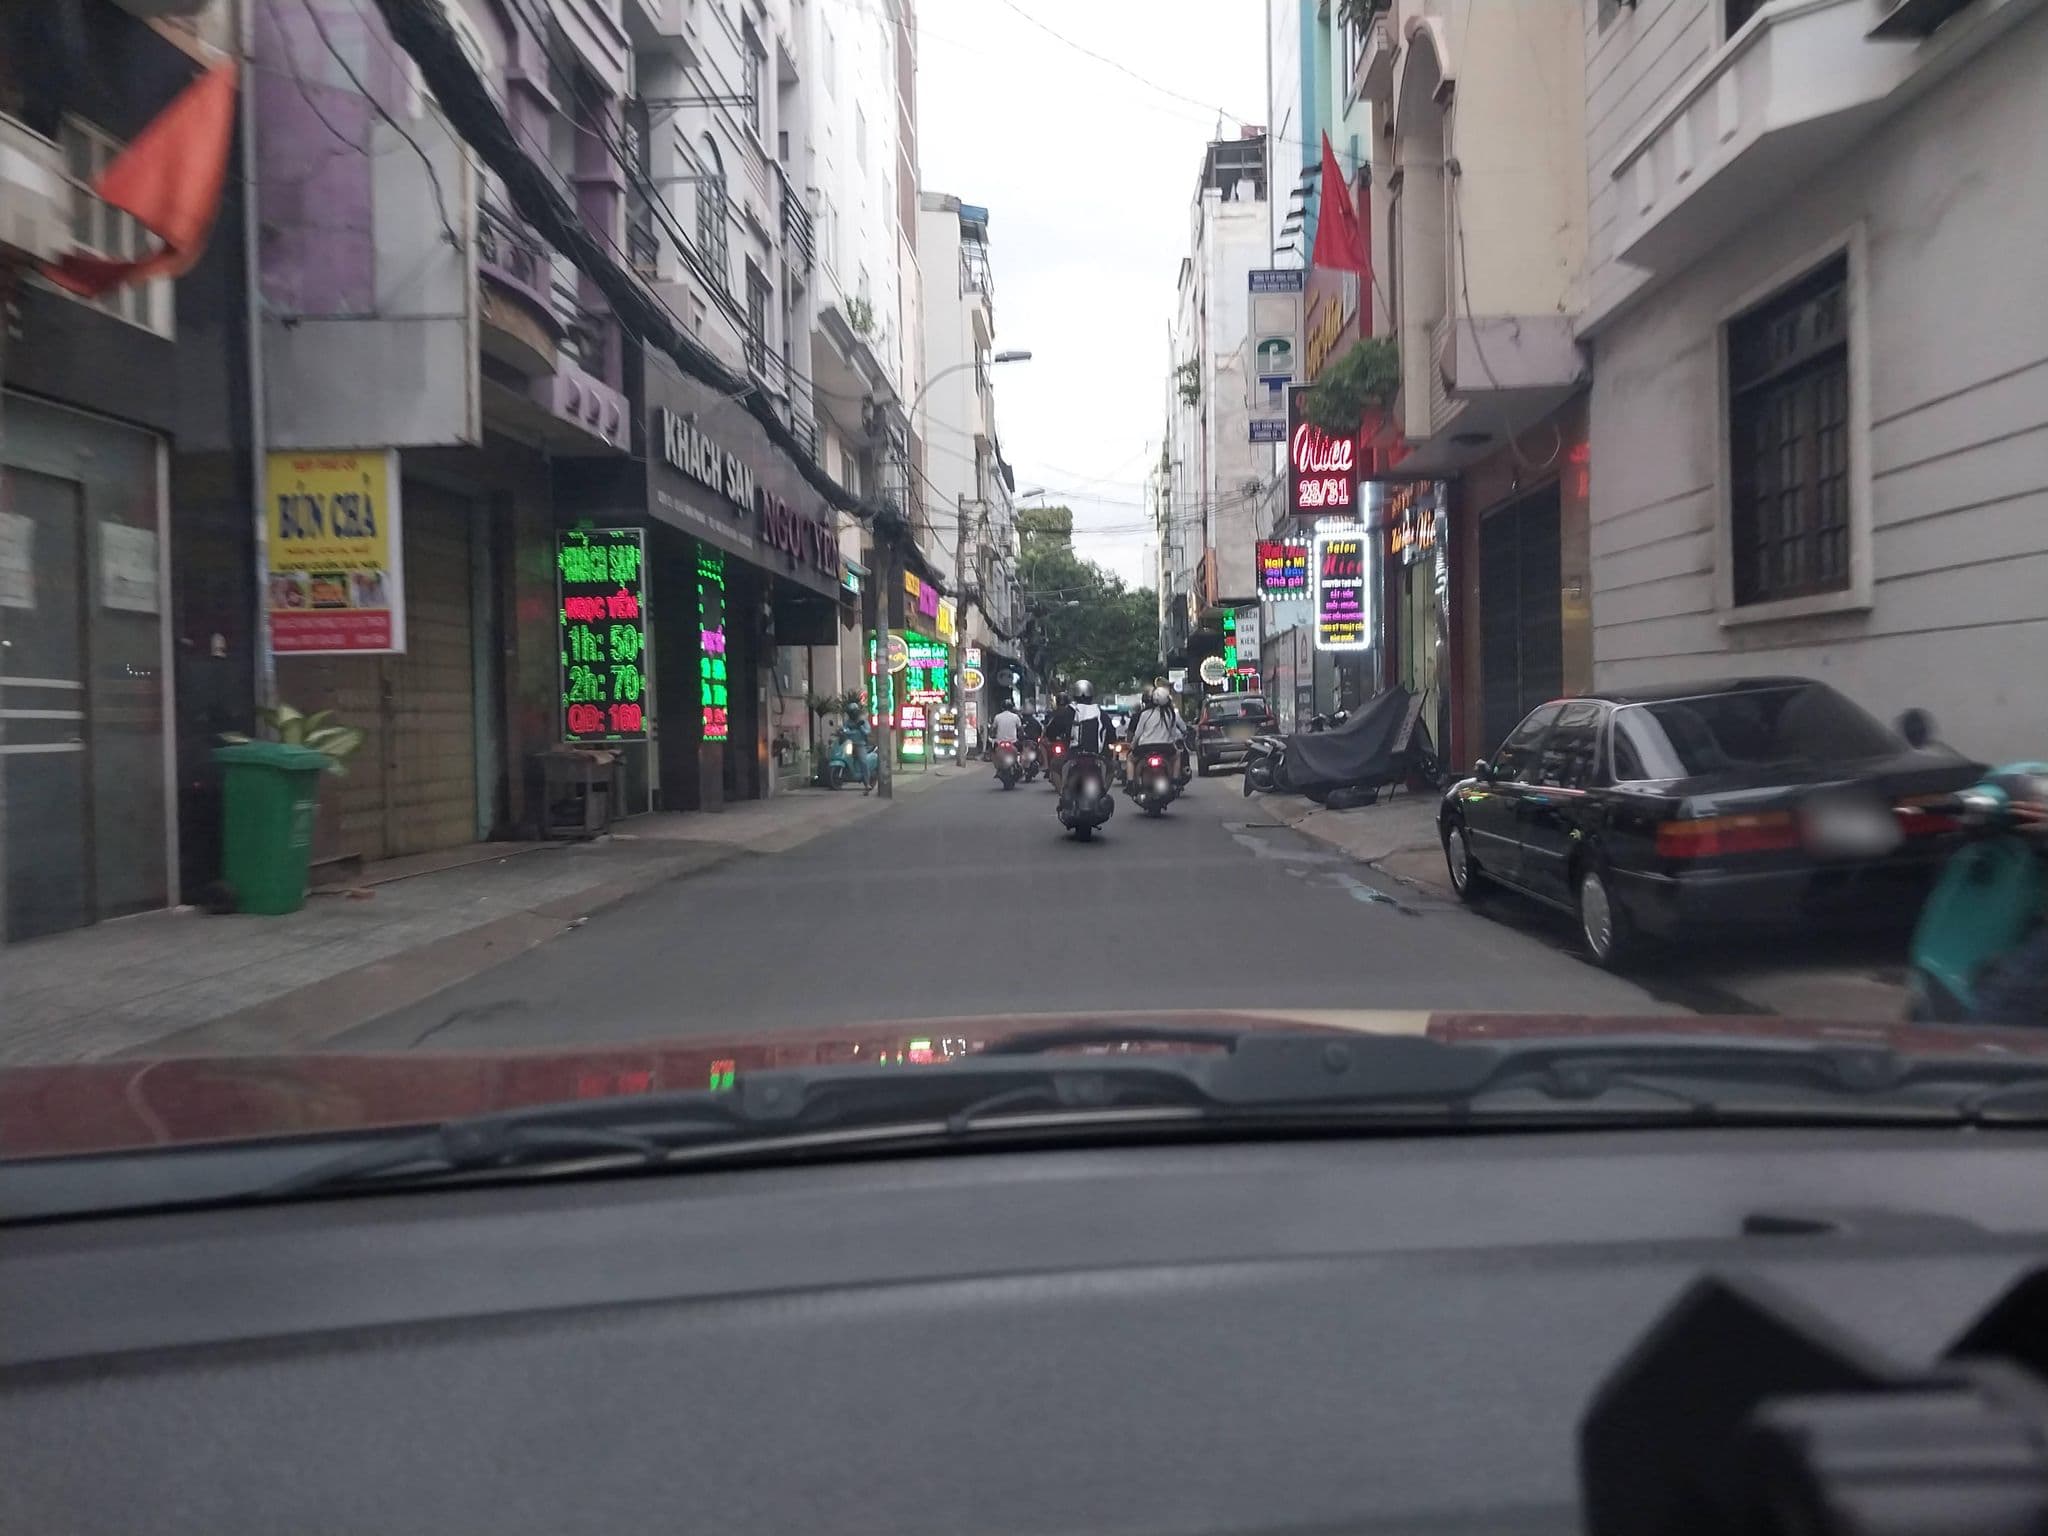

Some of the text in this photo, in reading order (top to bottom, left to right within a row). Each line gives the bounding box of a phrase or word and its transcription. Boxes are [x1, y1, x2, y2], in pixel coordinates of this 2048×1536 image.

[663, 405, 723, 495] KHÁCH
[725, 450, 755, 519] SẠN
[609, 665, 640, 702] 70
